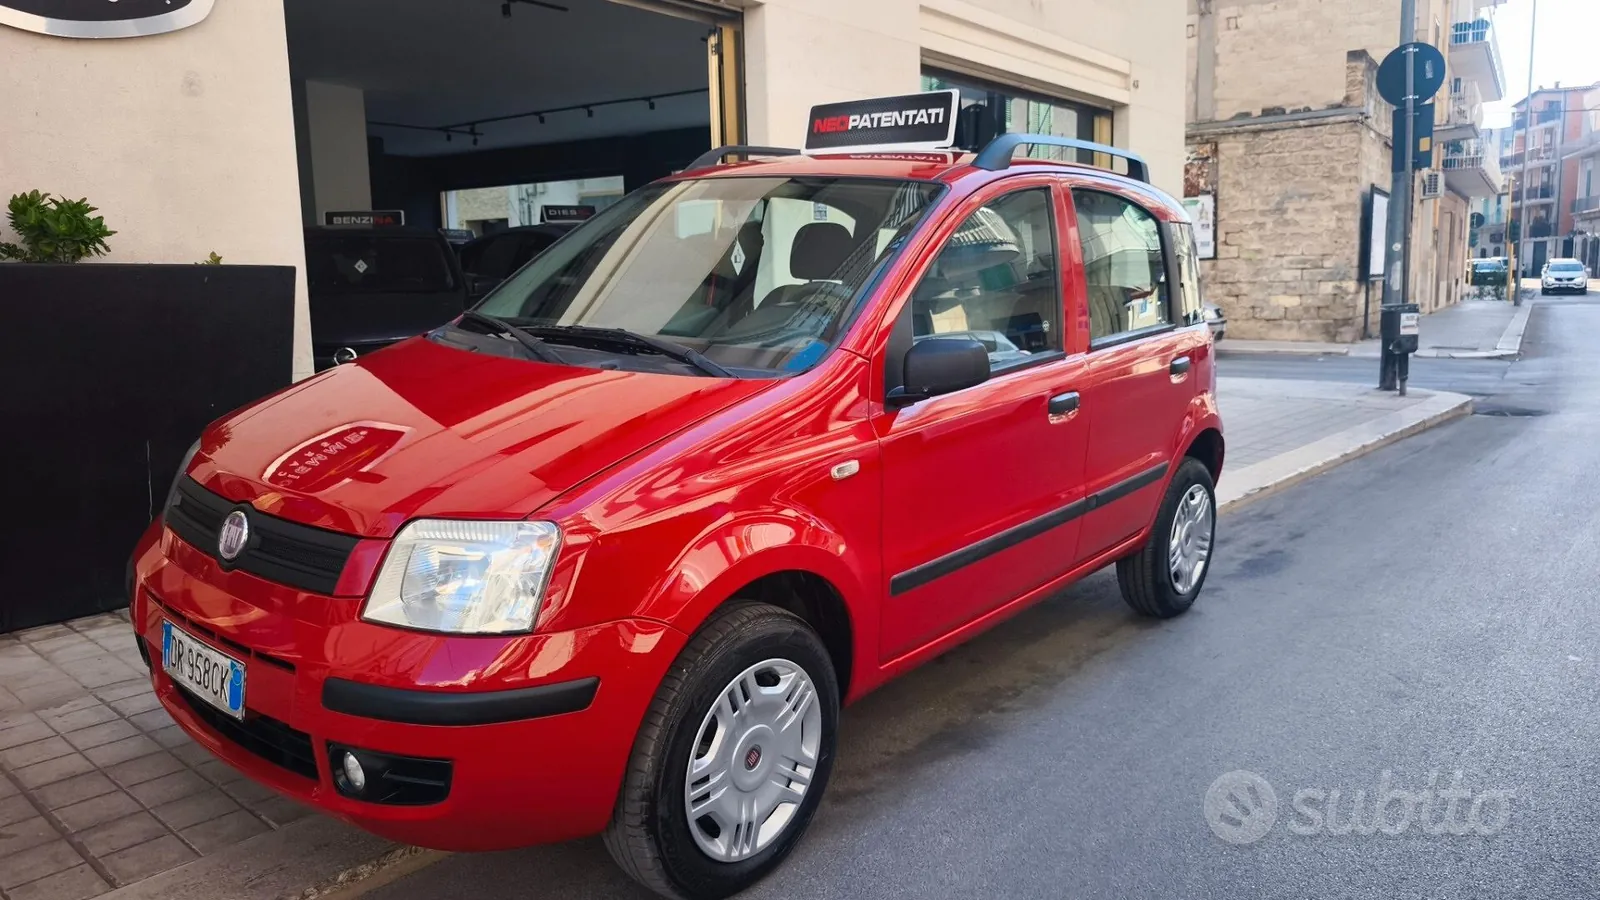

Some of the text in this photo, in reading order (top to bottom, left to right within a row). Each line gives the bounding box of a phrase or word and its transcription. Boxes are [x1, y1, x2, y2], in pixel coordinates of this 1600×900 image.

[813, 107, 945, 134] NEOPATENTATI
[332, 216, 394, 225] BENZINA
[170, 635, 229, 702] DR 958CK
